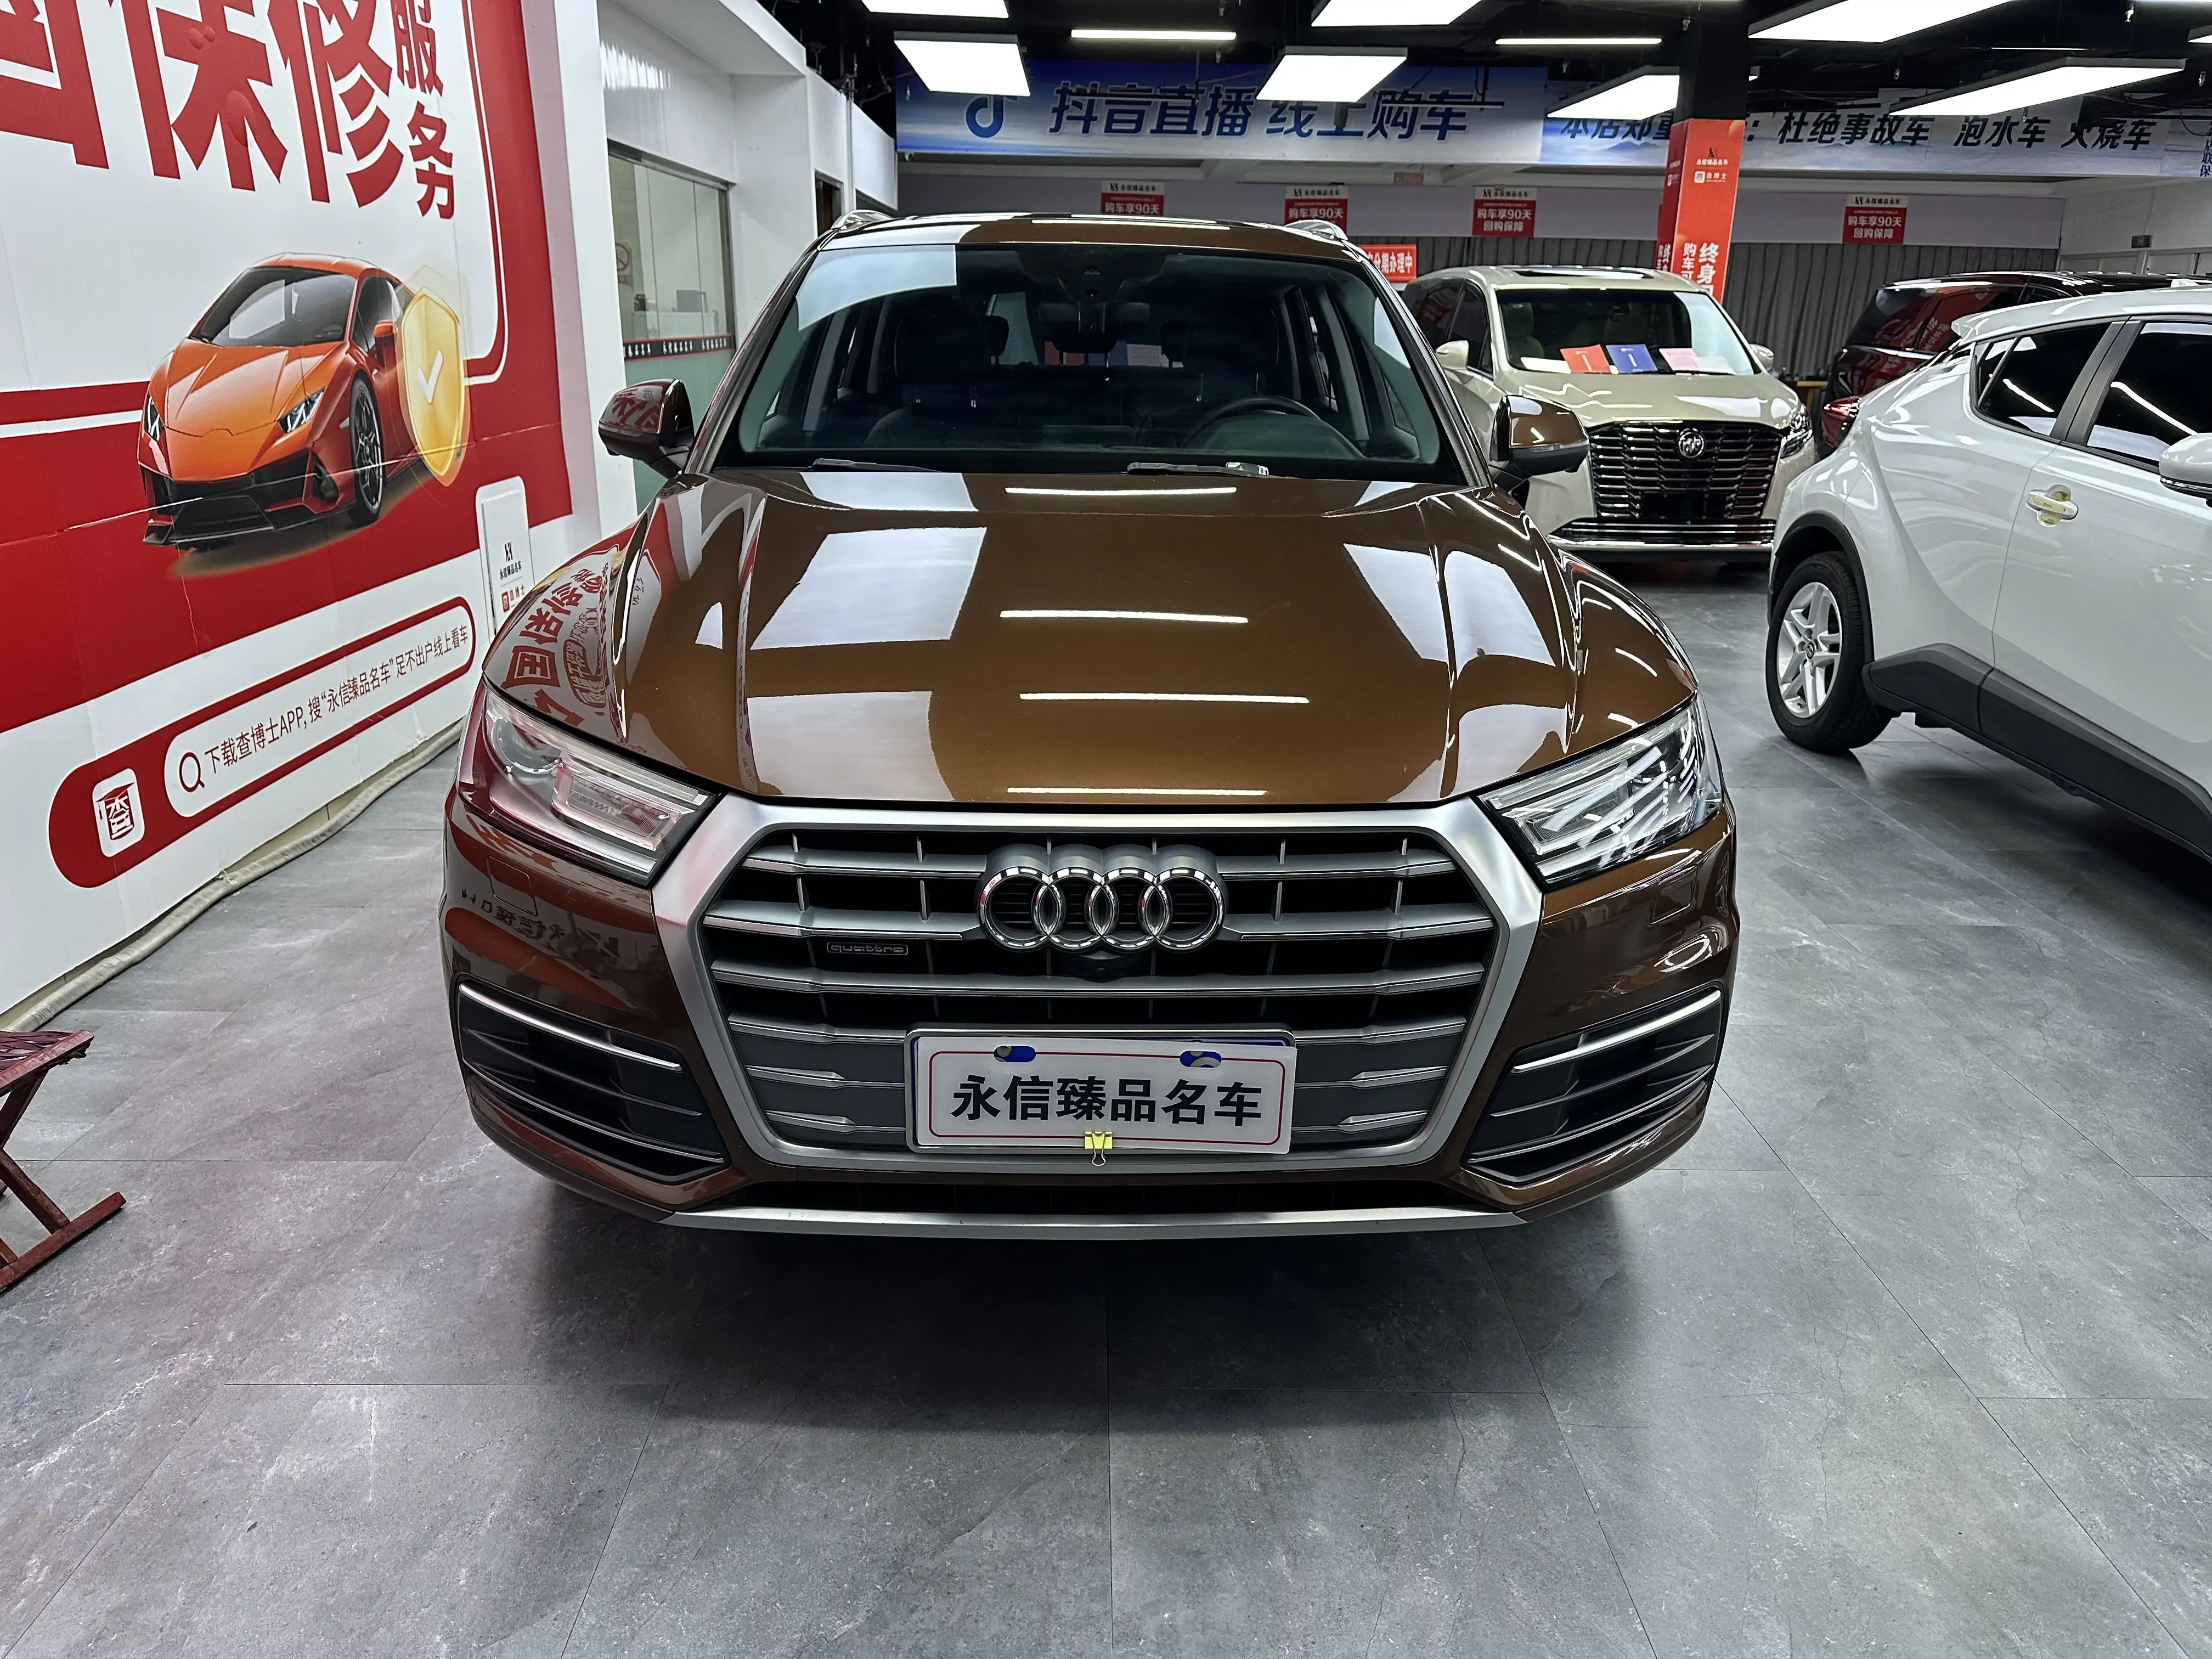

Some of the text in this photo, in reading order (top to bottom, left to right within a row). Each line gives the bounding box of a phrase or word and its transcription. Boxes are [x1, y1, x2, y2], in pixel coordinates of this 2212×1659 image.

[396, 0, 455, 219] 服务
[1048, 81, 1472, 140] 抖音直播 线上购车
[1288, 208, 1344, 219] 购车享90天
[1477, 208, 1532, 220] 购车享90天
[1483, 220, 1523, 232] 回购保障
[1847, 216, 1902, 227] 购车享90天
[1854, 228, 1893, 239] 回购保障
[1368, 251, 1413, 274] 分期办理中
[831, 945, 904, 953] quattro
[951, 1074, 1262, 1126] 永信臻品名车
